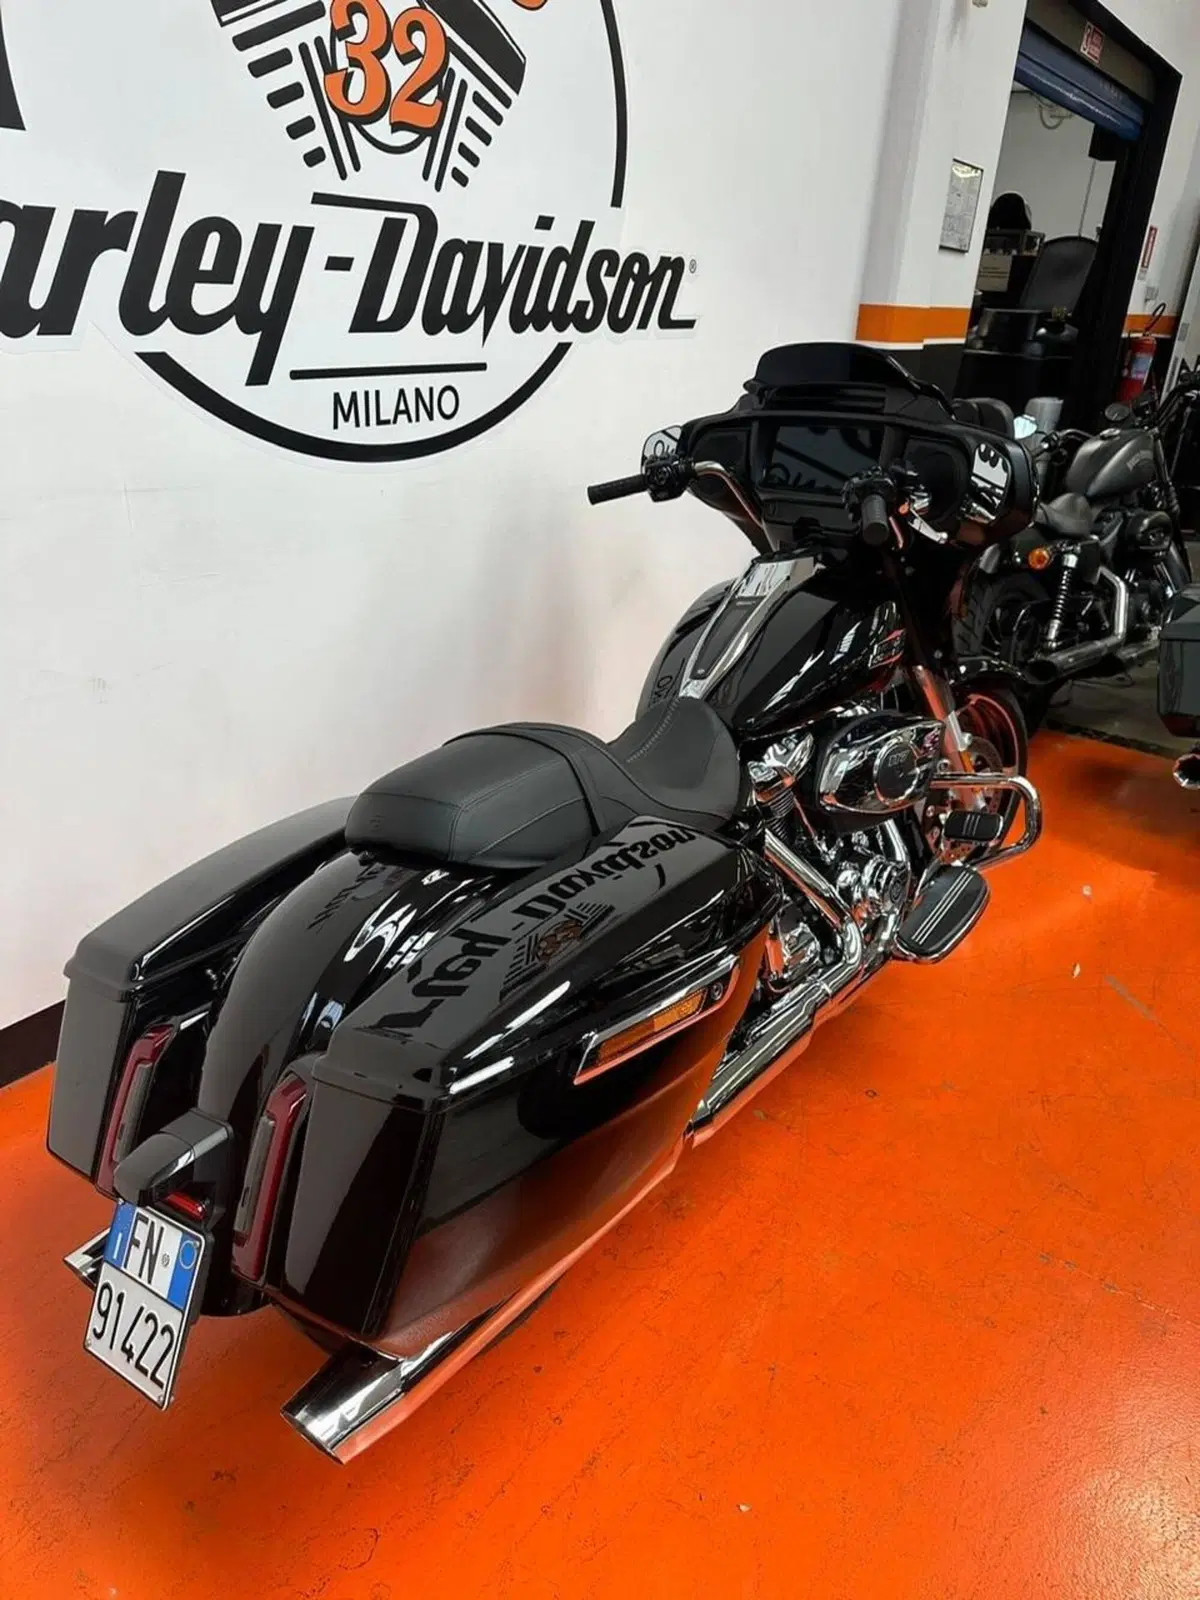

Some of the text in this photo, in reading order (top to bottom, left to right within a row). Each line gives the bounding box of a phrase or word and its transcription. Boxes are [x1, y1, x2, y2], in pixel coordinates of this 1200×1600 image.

[324, 0, 450, 136] 32
[331, 384, 460, 430] MILANO
[123, 1213, 165, 1285] FN
[92, 1281, 176, 1390] 91422
